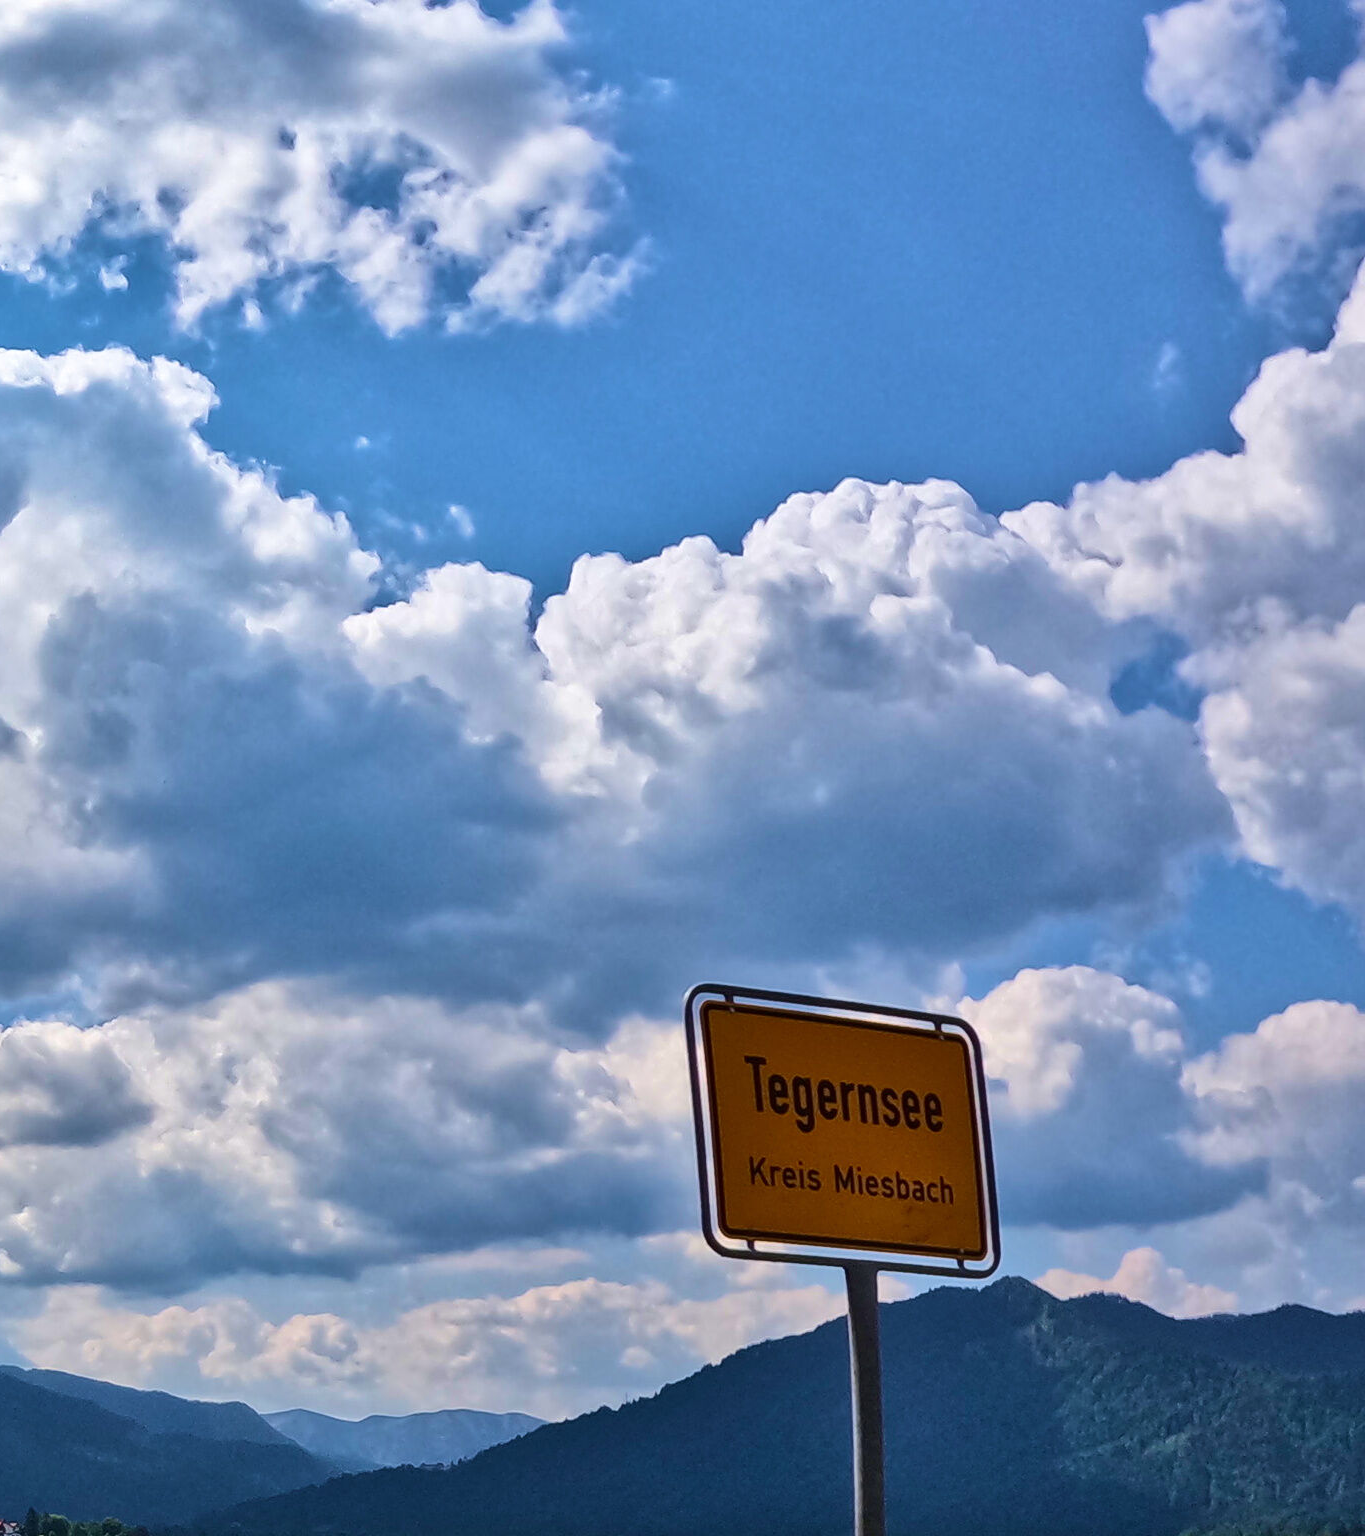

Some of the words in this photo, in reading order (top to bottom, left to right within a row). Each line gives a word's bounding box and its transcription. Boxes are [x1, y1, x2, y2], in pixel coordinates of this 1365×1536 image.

[744, 1055, 943, 1133] Tegernsee
[748, 1156, 822, 1191] Kreis
[833, 1164, 955, 1205] Miesbach
